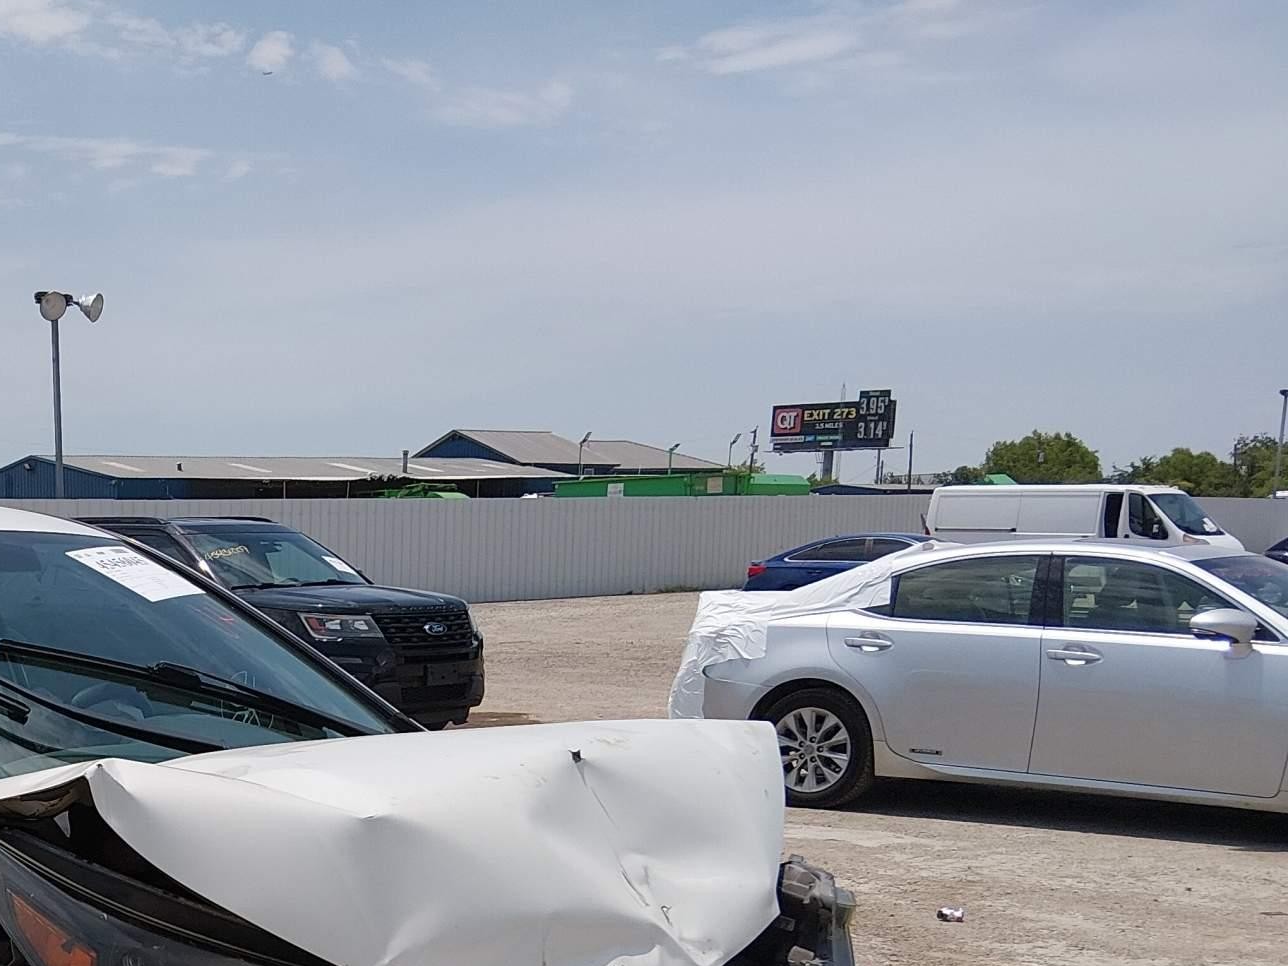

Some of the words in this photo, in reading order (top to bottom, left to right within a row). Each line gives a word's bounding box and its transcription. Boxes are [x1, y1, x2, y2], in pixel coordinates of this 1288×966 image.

[777, 412, 797, 429] QT
[804, 409, 830, 420] EXIT
[833, 408, 857, 419] 273
